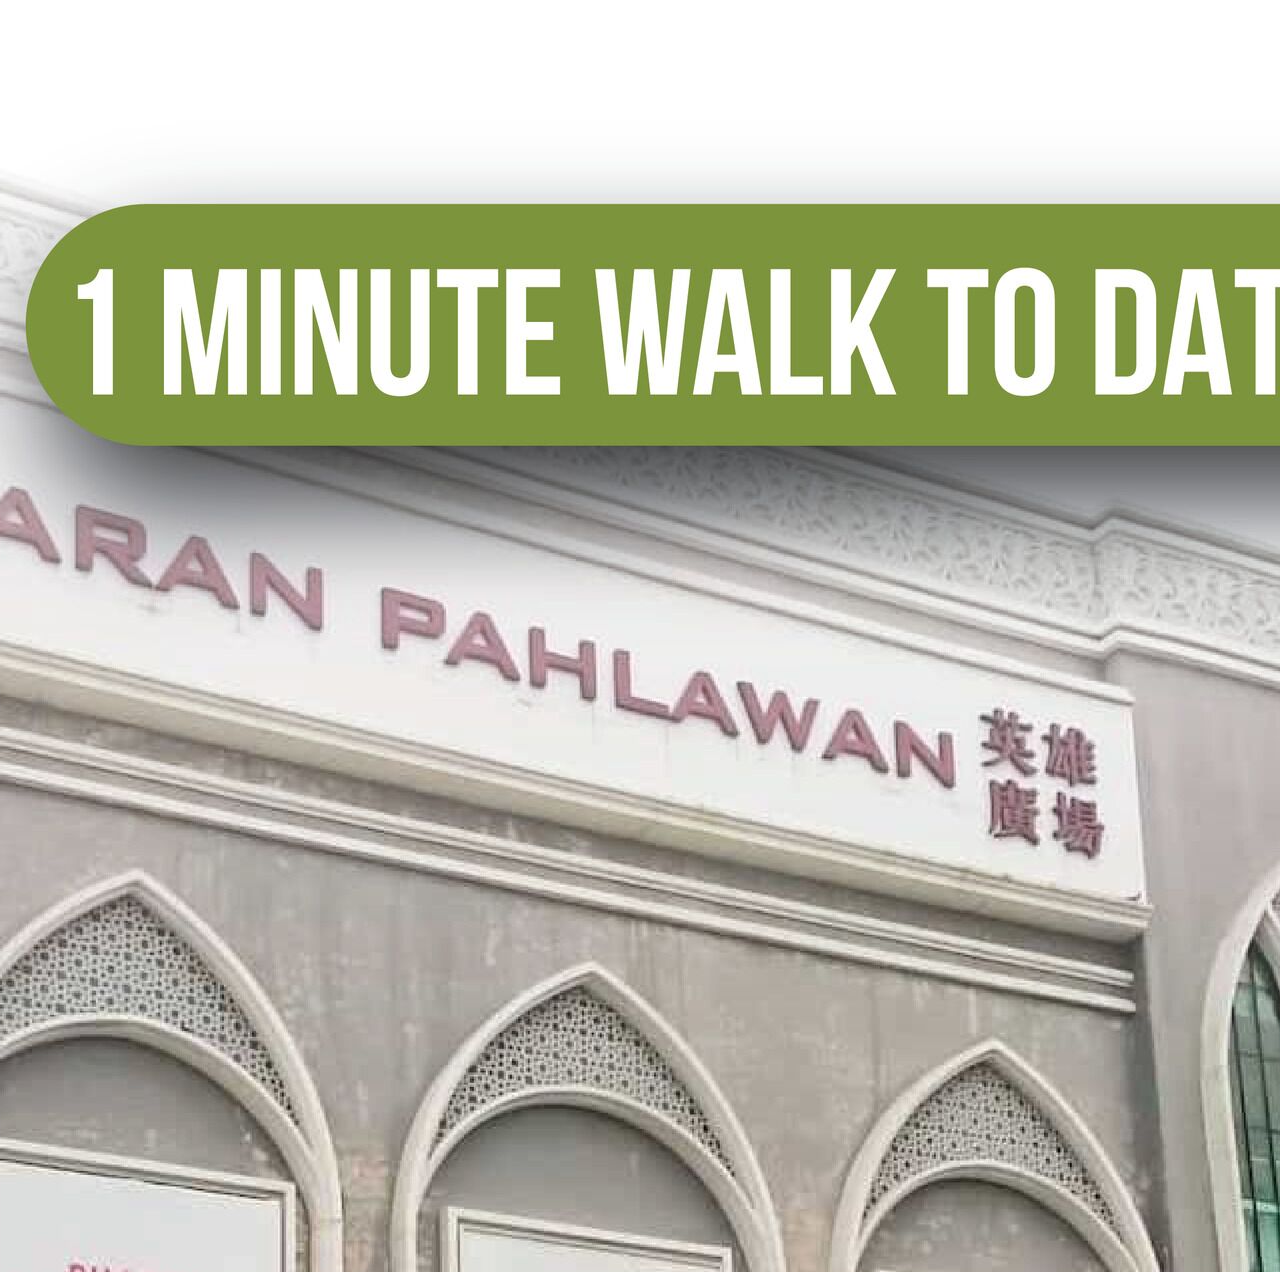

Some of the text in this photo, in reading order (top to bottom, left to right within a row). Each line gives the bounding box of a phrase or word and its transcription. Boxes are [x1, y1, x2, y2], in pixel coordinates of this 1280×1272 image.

[380, 586, 956, 789] PAHLAWAN
[979, 708, 1098, 787] 英雄
[987, 779, 1106, 860] 廣場
